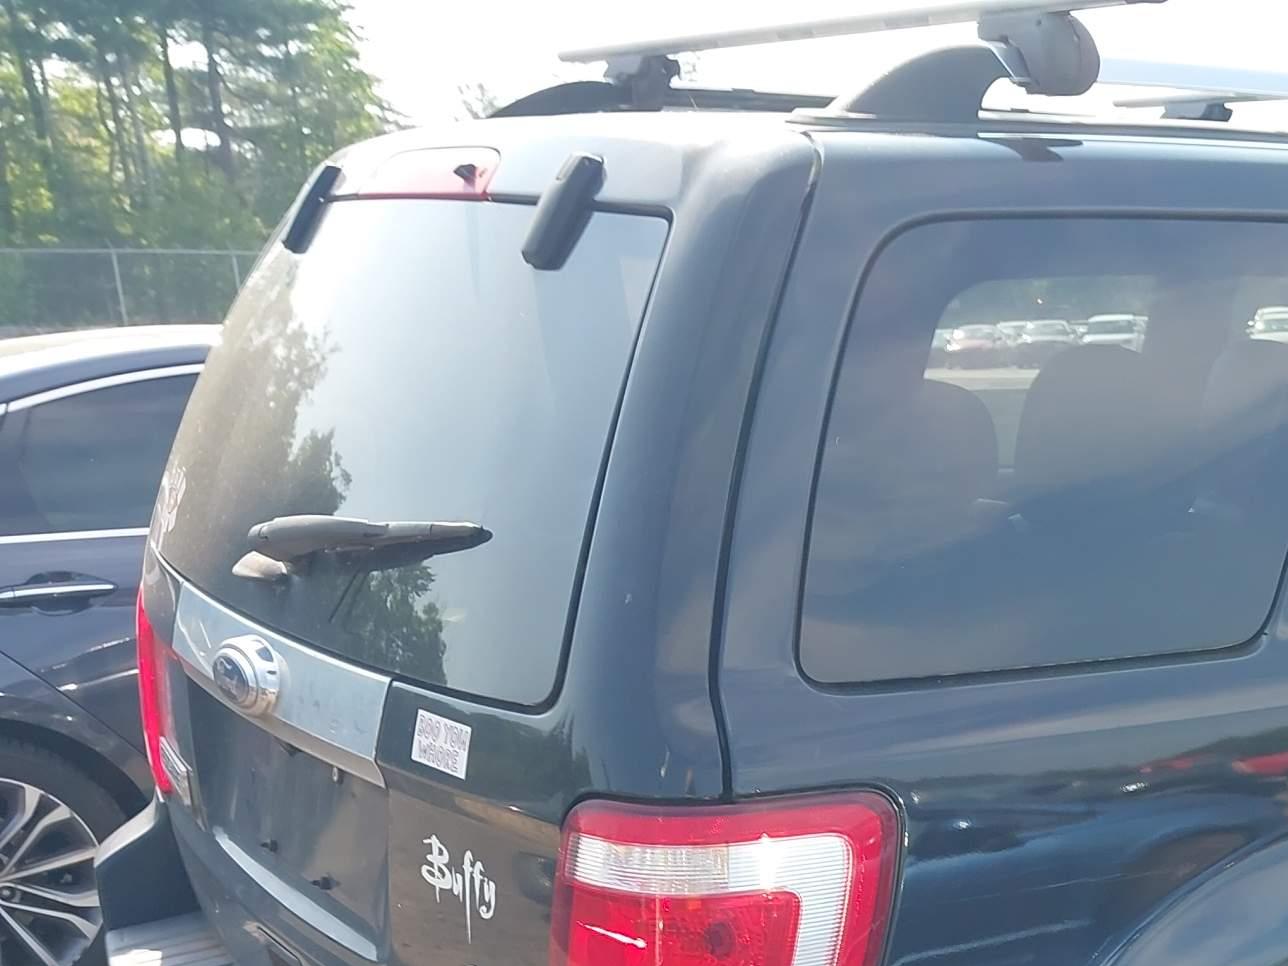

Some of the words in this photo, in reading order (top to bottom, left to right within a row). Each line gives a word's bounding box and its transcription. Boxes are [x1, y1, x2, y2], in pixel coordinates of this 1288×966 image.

[416, 713, 441, 743] BOO
[443, 722, 469, 752] YOU
[417, 738, 459, 774] WHORE
[421, 834, 496, 944] Buffy
